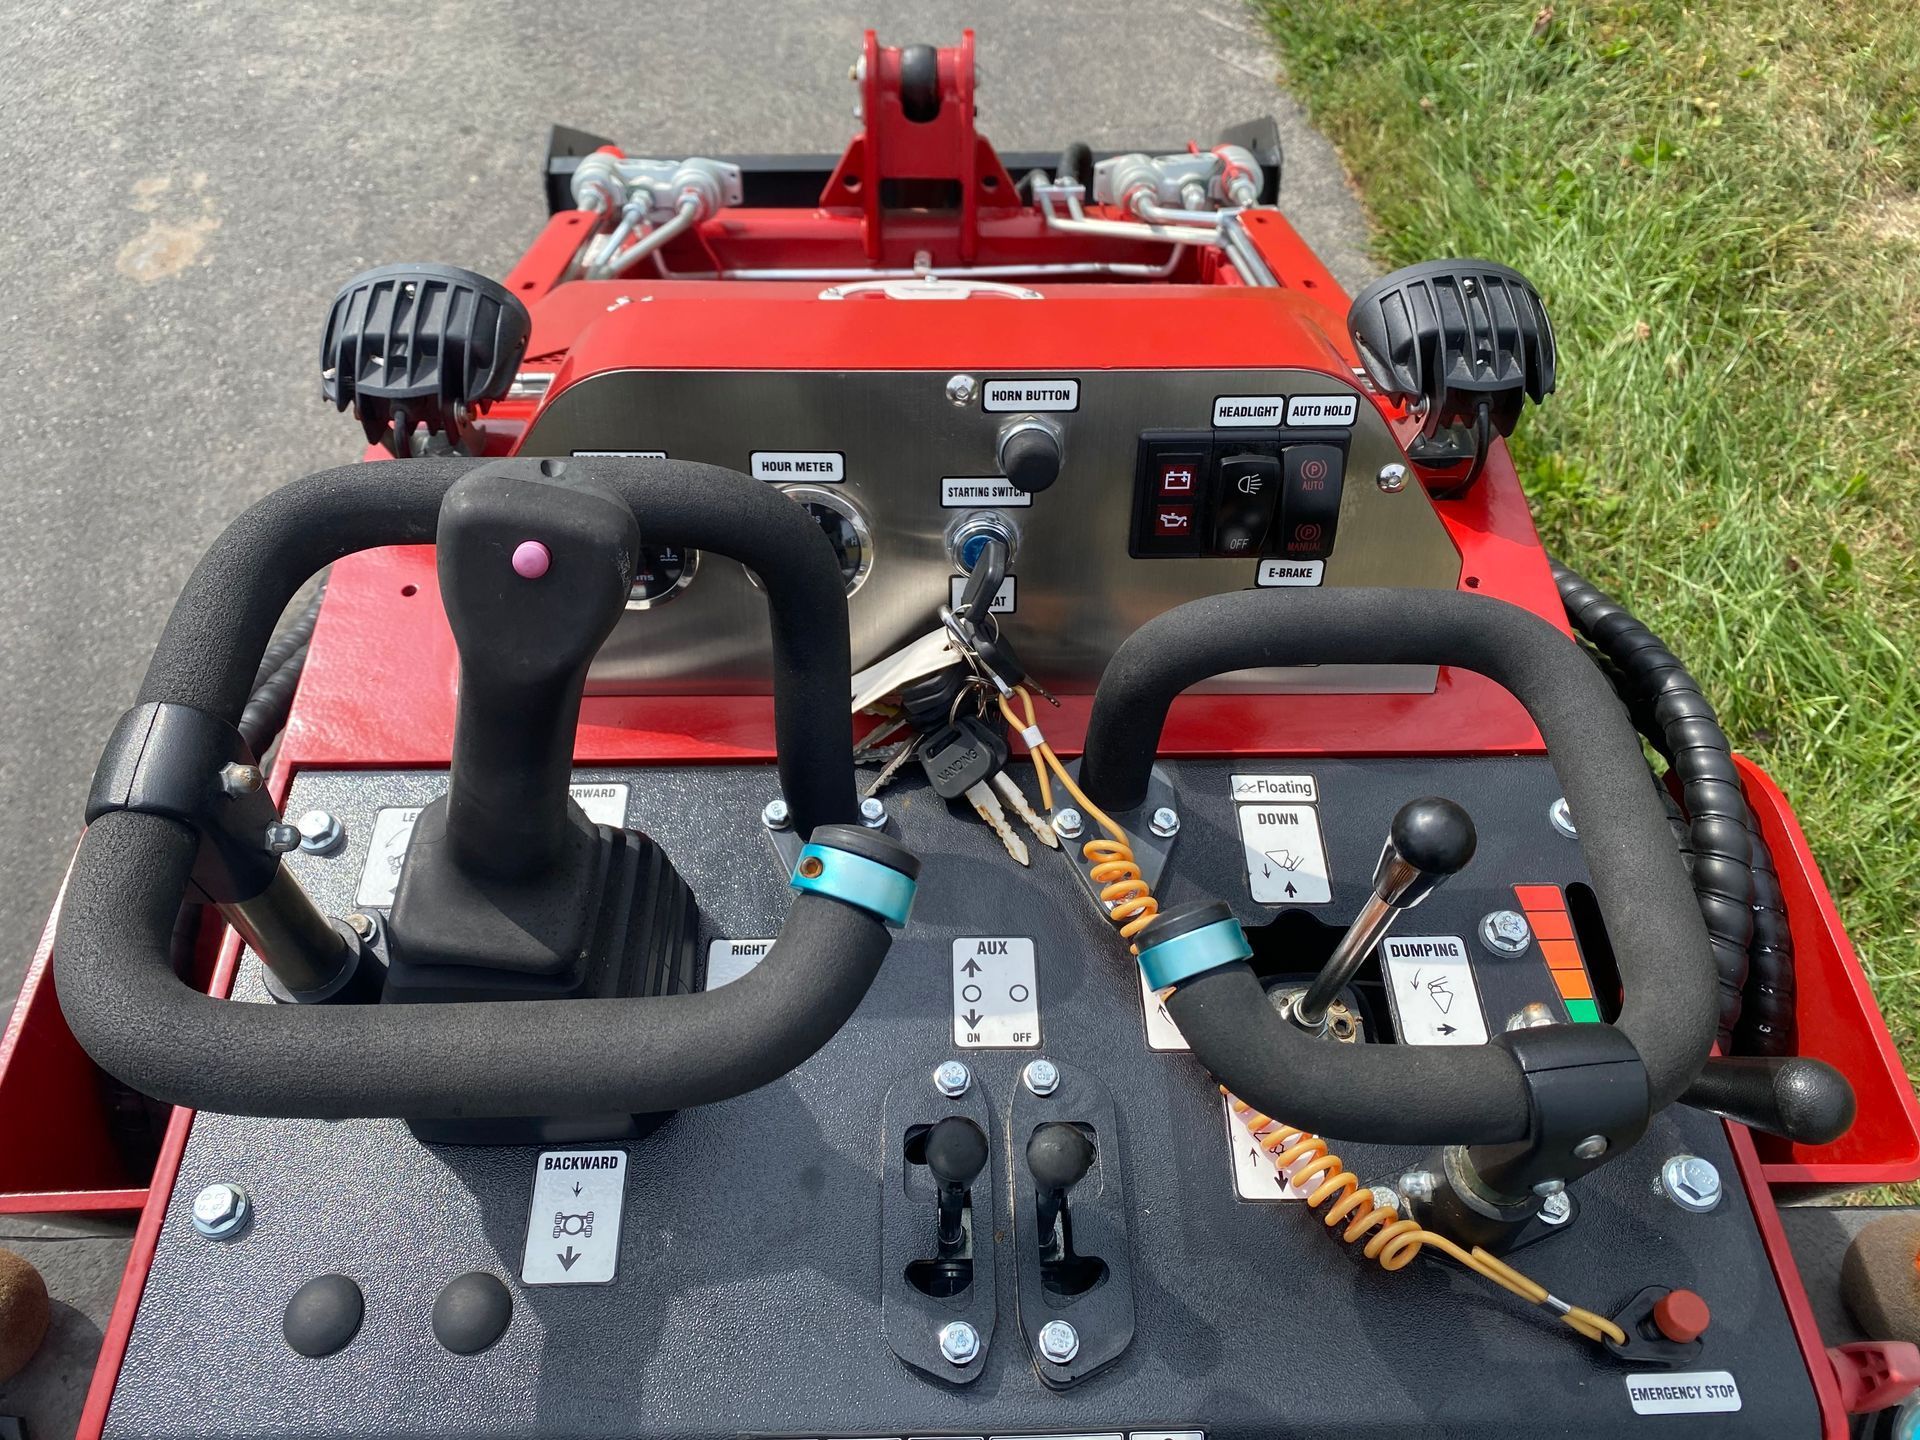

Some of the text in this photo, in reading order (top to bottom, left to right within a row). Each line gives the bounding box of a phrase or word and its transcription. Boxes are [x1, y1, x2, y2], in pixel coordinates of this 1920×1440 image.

[992, 390, 1070, 401] HORN BUTTON
[1219, 406, 1279, 418] HEADLIGHT
[1292, 405, 1352, 417] AUTO HOLD
[762, 461, 833, 473] HOUR METER
[948, 487, 990, 497] STARTING
[1302, 481, 1324, 491] AUTO
[1229, 538, 1249, 550] OFF
[1288, 541, 1321, 552] MANUAL
[1268, 568, 1313, 579] E-BRAKE
[569, 788, 616, 798] ORWARD
[1256, 780, 1312, 796] Floating
[1257, 813, 1299, 825] DOWN
[731, 944, 767, 955] RIGHT
[976, 941, 1009, 955] AUX
[1390, 943, 1459, 957] DUMPING
[967, 1032, 981, 1043] ON
[1012, 1032, 1032, 1043] OFF
[544, 1156, 618, 1170] BACKWARD
[1630, 1384, 1735, 1401] EMERGENCY STOP
